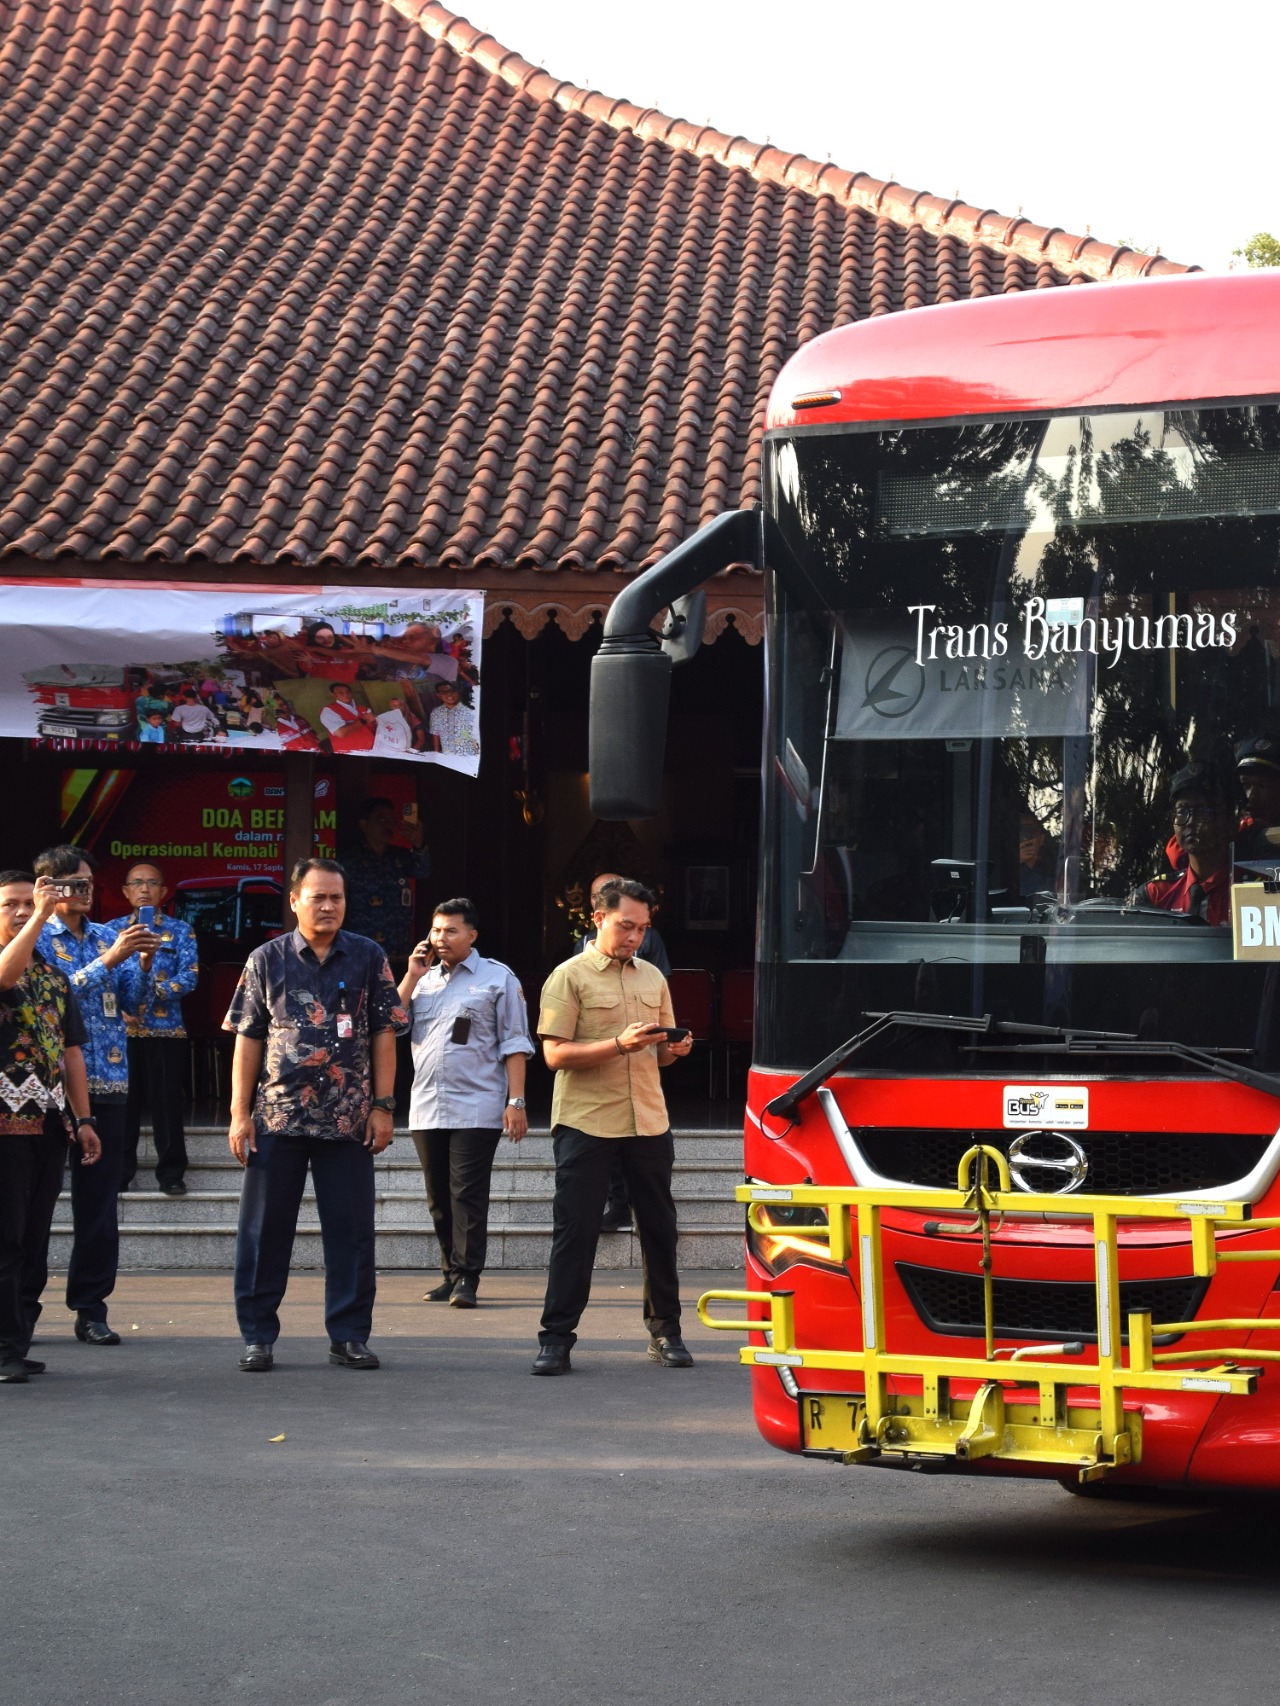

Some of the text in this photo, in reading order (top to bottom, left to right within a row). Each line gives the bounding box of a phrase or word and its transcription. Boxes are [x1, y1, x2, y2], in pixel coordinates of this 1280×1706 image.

[907, 604, 1009, 667] Trans
[1023, 596, 1237, 669] Banyumas
[939, 666, 1066, 693] LAKSANA
[202, 808, 243, 829] DOA
[235, 831, 273, 841] dalam
[110, 840, 208, 859] Operasional
[212, 842, 278, 858] Kembali
[1008, 1099, 1040, 1116] Bus
[810, 1399, 823, 1430] R
